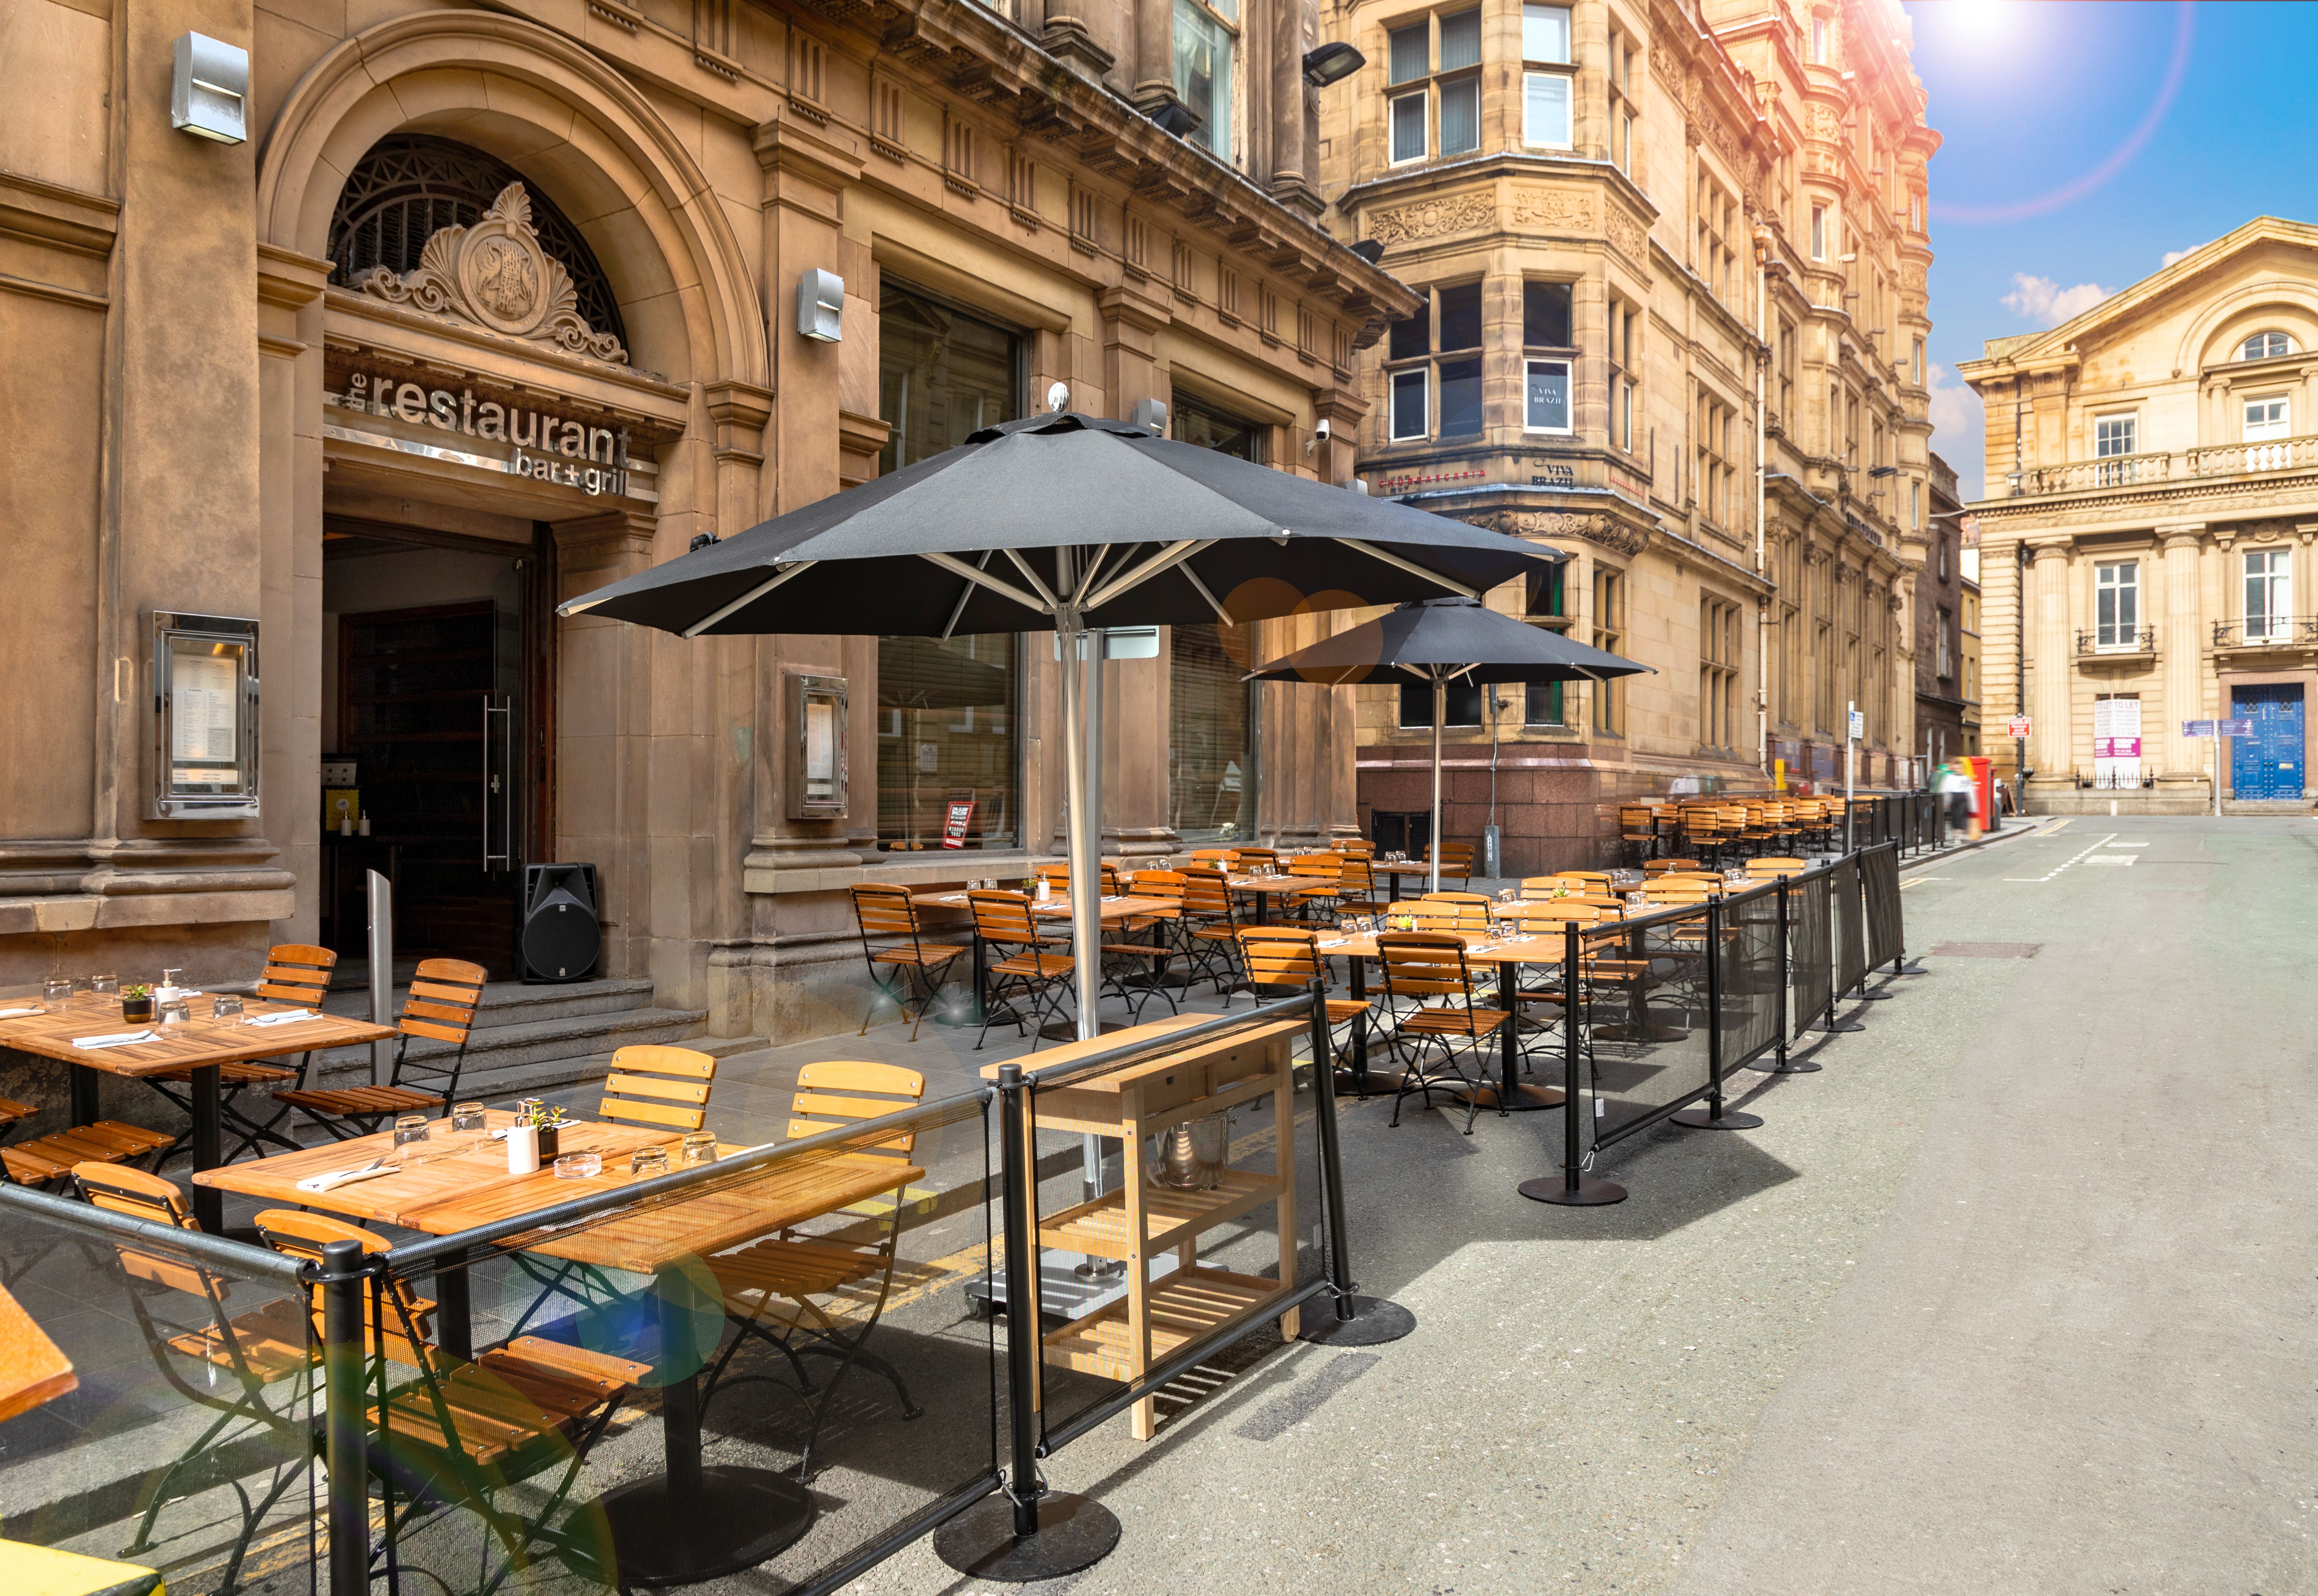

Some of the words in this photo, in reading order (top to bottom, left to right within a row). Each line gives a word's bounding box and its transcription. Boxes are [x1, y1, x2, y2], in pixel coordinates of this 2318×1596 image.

[1534, 396, 1563, 405] BRAZIL
[346, 373, 367, 412] the
[373, 376, 632, 469] restaurant
[1547, 465, 1573, 476] VIVA
[1379, 469, 1486, 488] CHURRASCARIA
[1532, 475, 1576, 487] BRAZIL
